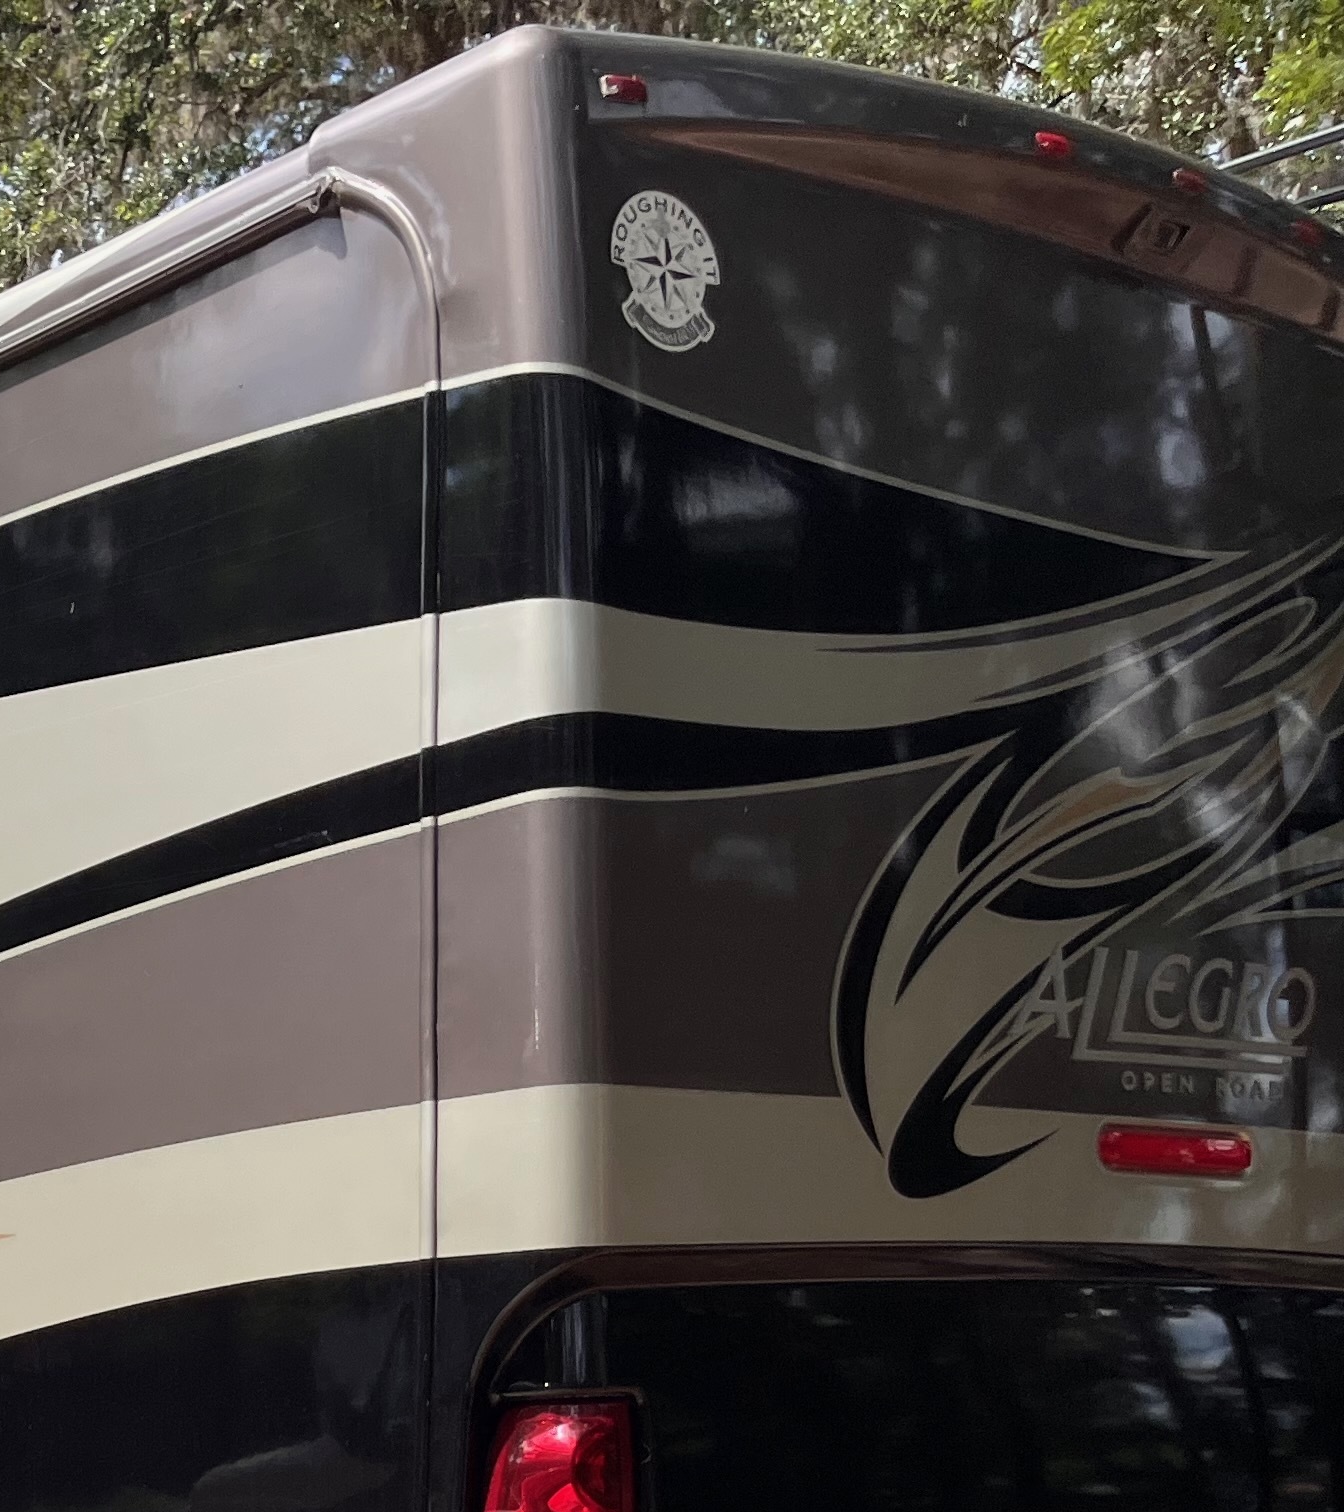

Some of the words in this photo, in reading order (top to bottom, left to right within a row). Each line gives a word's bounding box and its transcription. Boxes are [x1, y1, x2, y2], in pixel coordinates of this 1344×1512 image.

[613, 196, 707, 263] ROUGHING
[703, 256, 719, 284] IT
[1008, 942, 1316, 1074] ALLEGRO
[1120, 1070, 1195, 1094] OPEN
[1214, 1076, 1285, 1099] ROAD
